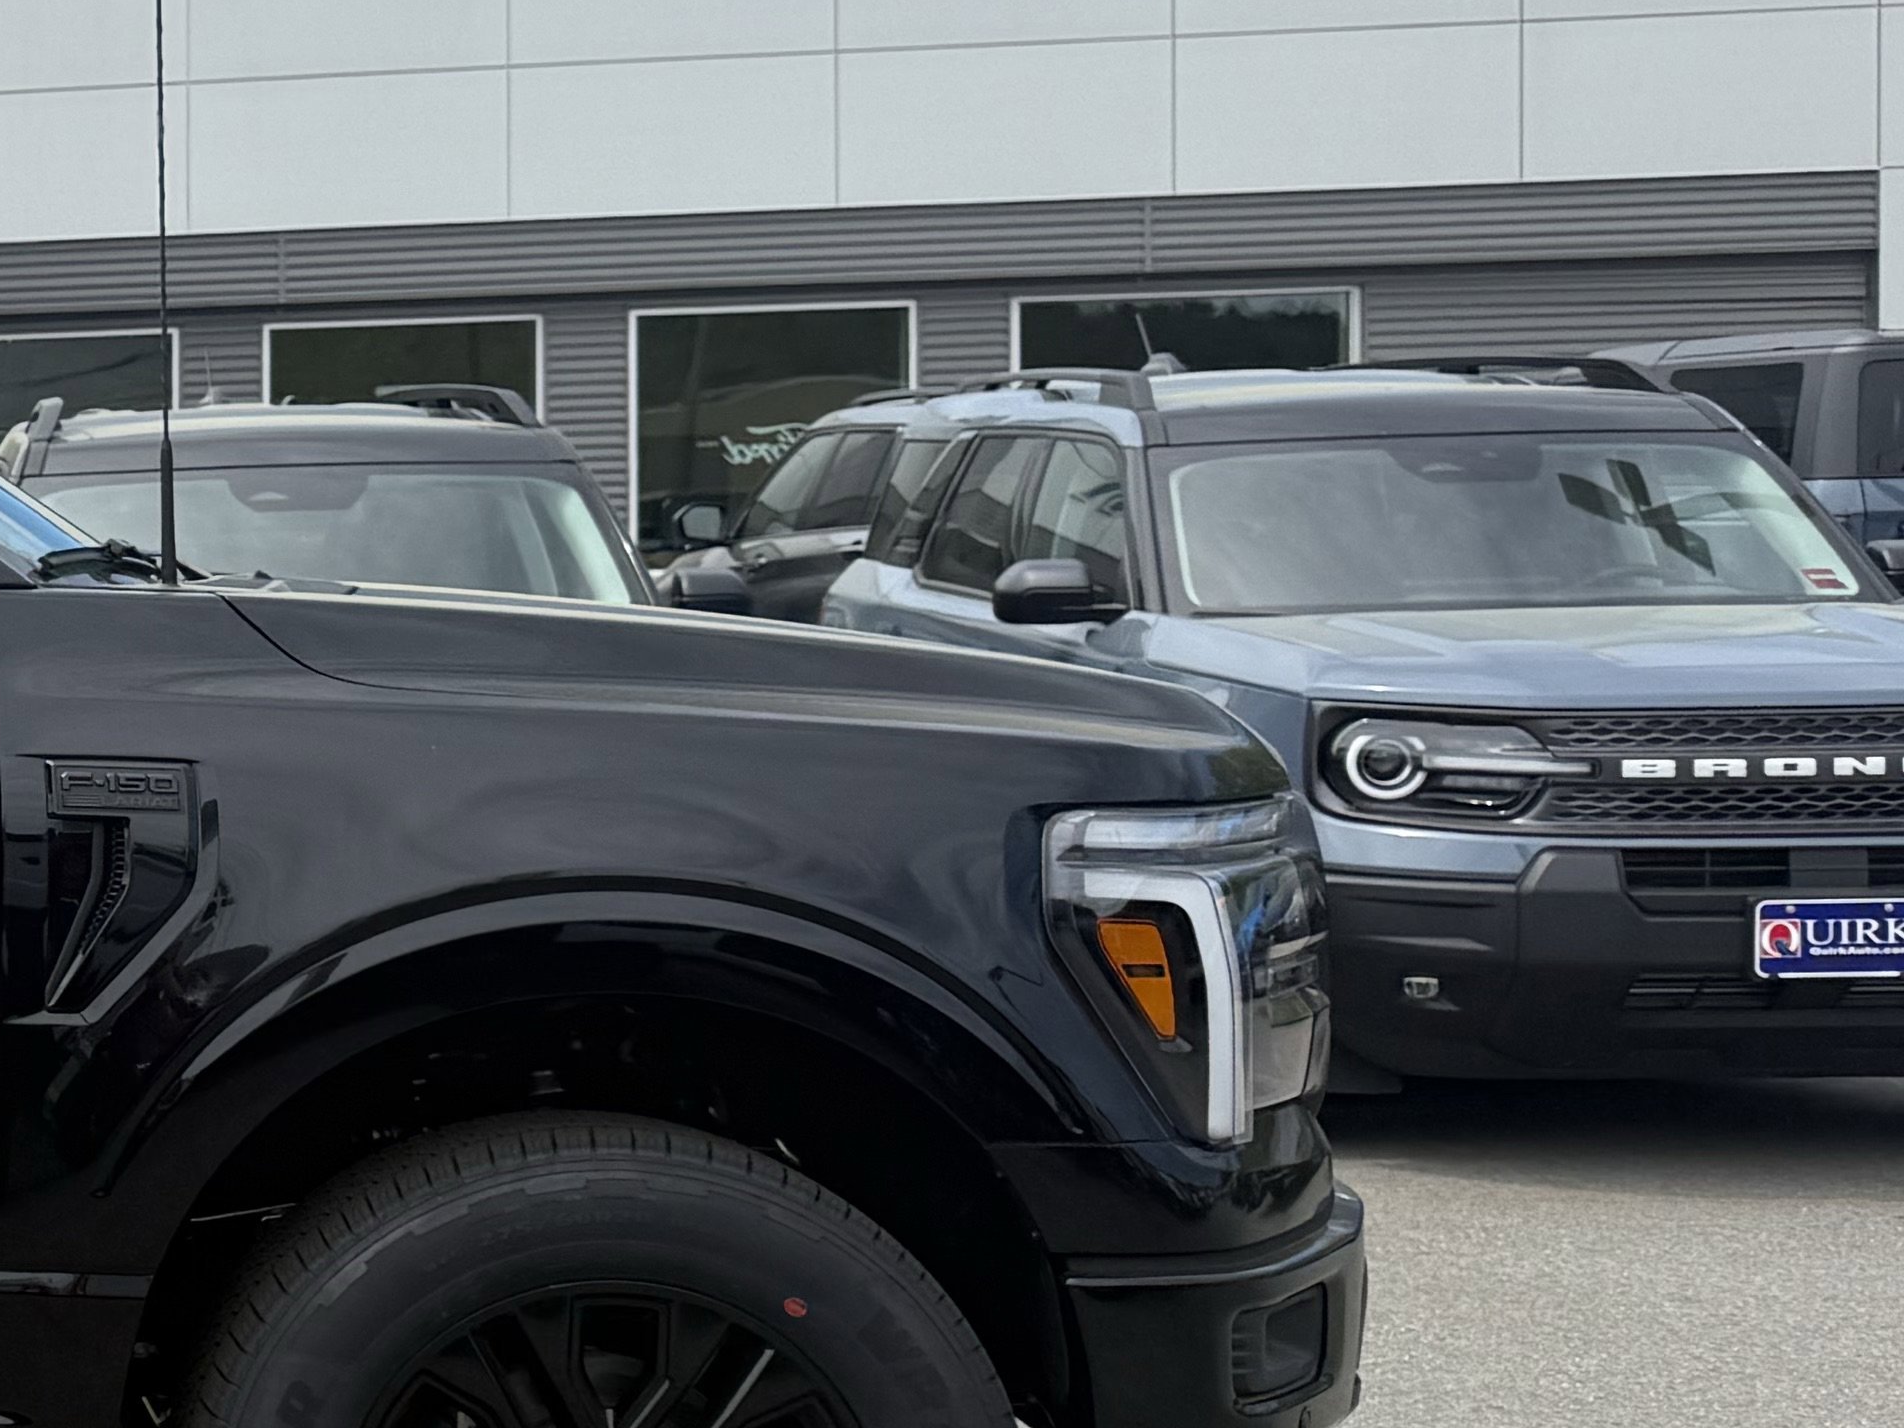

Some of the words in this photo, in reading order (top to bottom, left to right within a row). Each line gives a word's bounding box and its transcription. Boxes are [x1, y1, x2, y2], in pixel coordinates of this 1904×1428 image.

[1621, 756, 1904, 778] BRON
[59, 770, 179, 794] F-150
[1761, 918, 1904, 958] QUIRK
